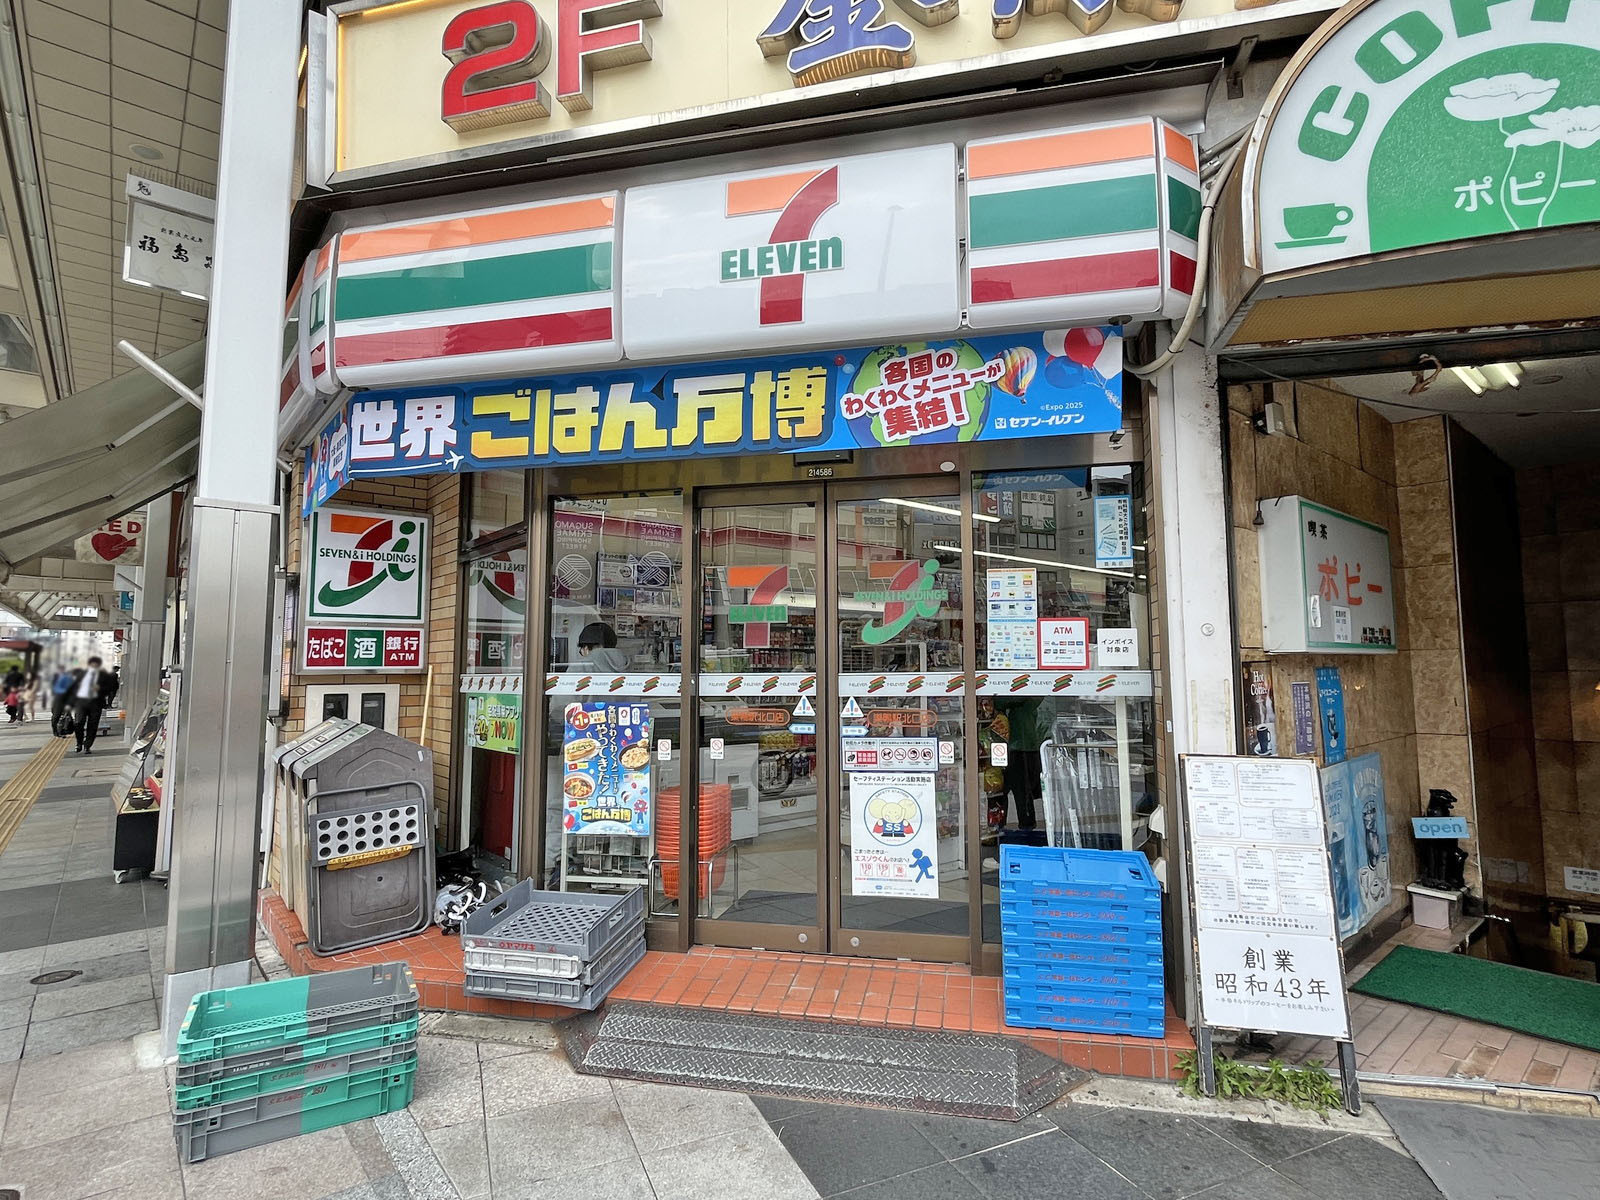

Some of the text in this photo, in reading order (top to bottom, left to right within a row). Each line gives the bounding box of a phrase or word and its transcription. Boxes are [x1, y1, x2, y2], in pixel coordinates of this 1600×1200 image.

[443, 0, 662, 118] 2F
[1454, 171, 1597, 211] ポピー
[884, 352, 953, 384] 各国の
[844, 363, 1002, 415] わくわくメニューが
[1066, 402, 1084, 410] 2025
[808, 468, 833, 477] 214586
[1308, 520, 1328, 540] 喫茶
[366, 552, 417, 564] HOLDINGS
[1053, 627, 1073, 635] ATM
[308, 637, 345, 659] たばこ
[354, 638, 377, 659] 酒
[386, 637, 419, 650] 銀行
[390, 653, 415, 661] ATM
[597, 796, 616, 807] 世界
[885, 823, 901, 831] SS
[1419, 822, 1463, 836] open
[1242, 946, 1296, 973] 創業
[1215, 973, 1330, 1003] 昭和43年
